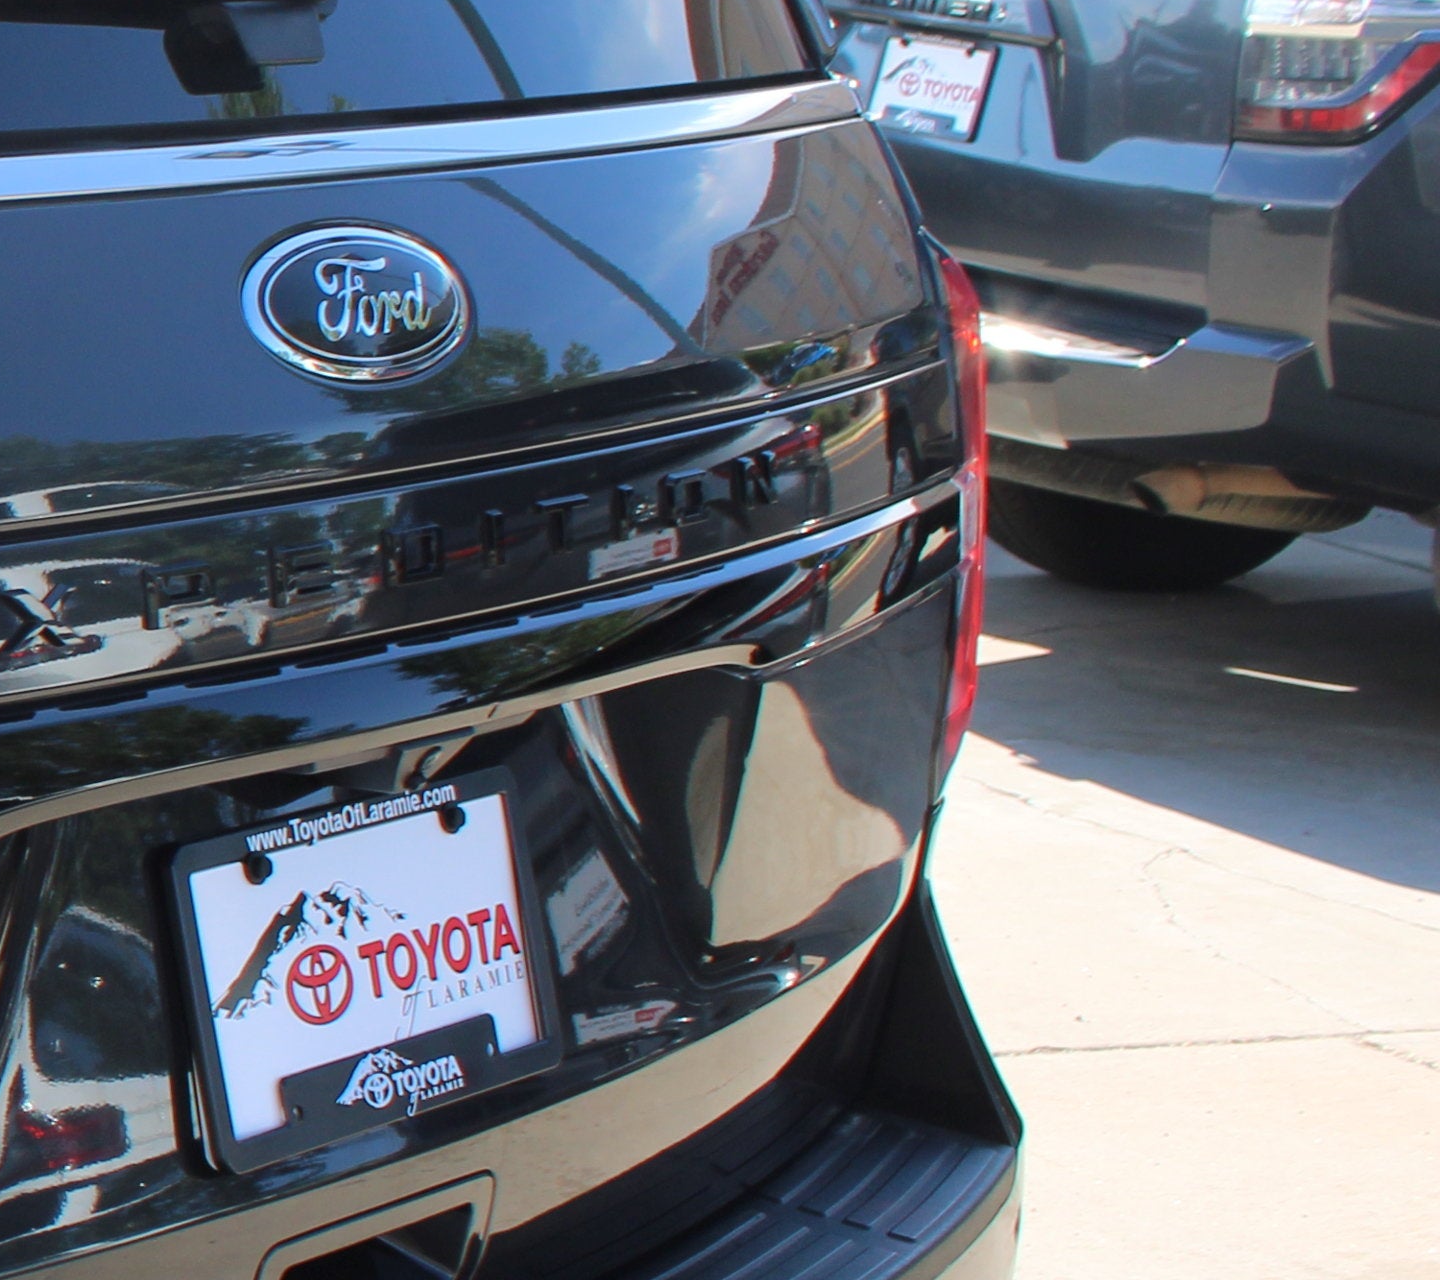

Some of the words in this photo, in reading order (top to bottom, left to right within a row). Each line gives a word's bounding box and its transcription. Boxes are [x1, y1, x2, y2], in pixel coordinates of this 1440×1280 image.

[924, 78, 983, 103] TOYOTA
[314, 257, 433, 342] Ford
[245, 784, 457, 853] www.ToyotaOfLaramie.com
[357, 903, 522, 999] TOYOTA
[428, 960, 526, 1009] LARAMIE
[391, 1054, 464, 1097] TOYOTA
[420, 1077, 465, 1101] LARAMIE
